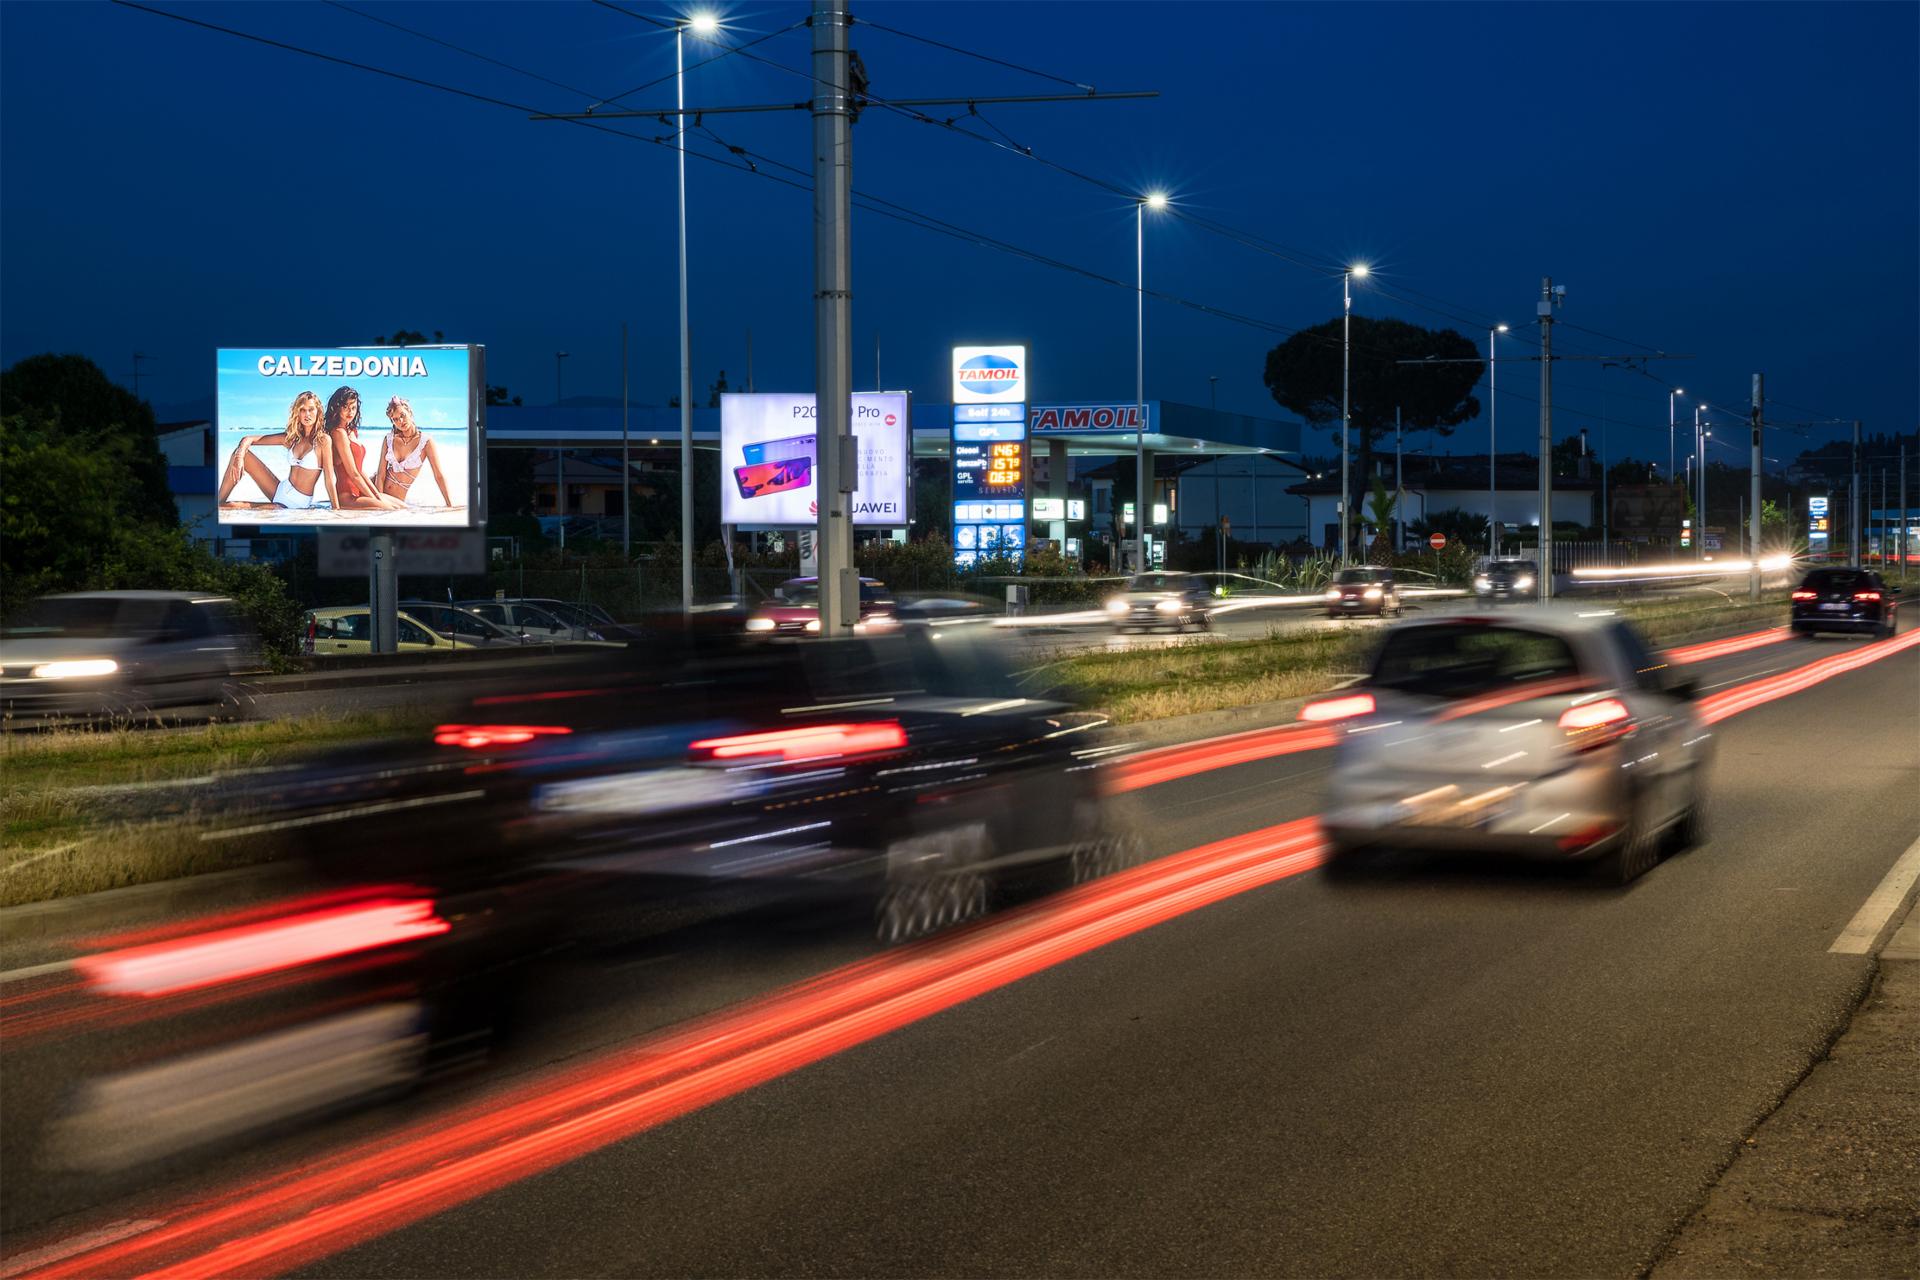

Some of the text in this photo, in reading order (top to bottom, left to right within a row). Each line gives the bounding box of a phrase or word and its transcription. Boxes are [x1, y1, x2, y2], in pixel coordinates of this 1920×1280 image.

[257, 355, 428, 377] CALZEDONIA
[958, 368, 1020, 381] TAMOIL
[858, 406, 880, 418] Pro
[968, 407, 1011, 417] Self 24h
[1031, 407, 1145, 429] TAMOIL
[978, 428, 1001, 437] GPL
[956, 446, 979, 456] Diesel
[957, 472, 973, 480] GPL
[852, 502, 897, 513] UAWEI
